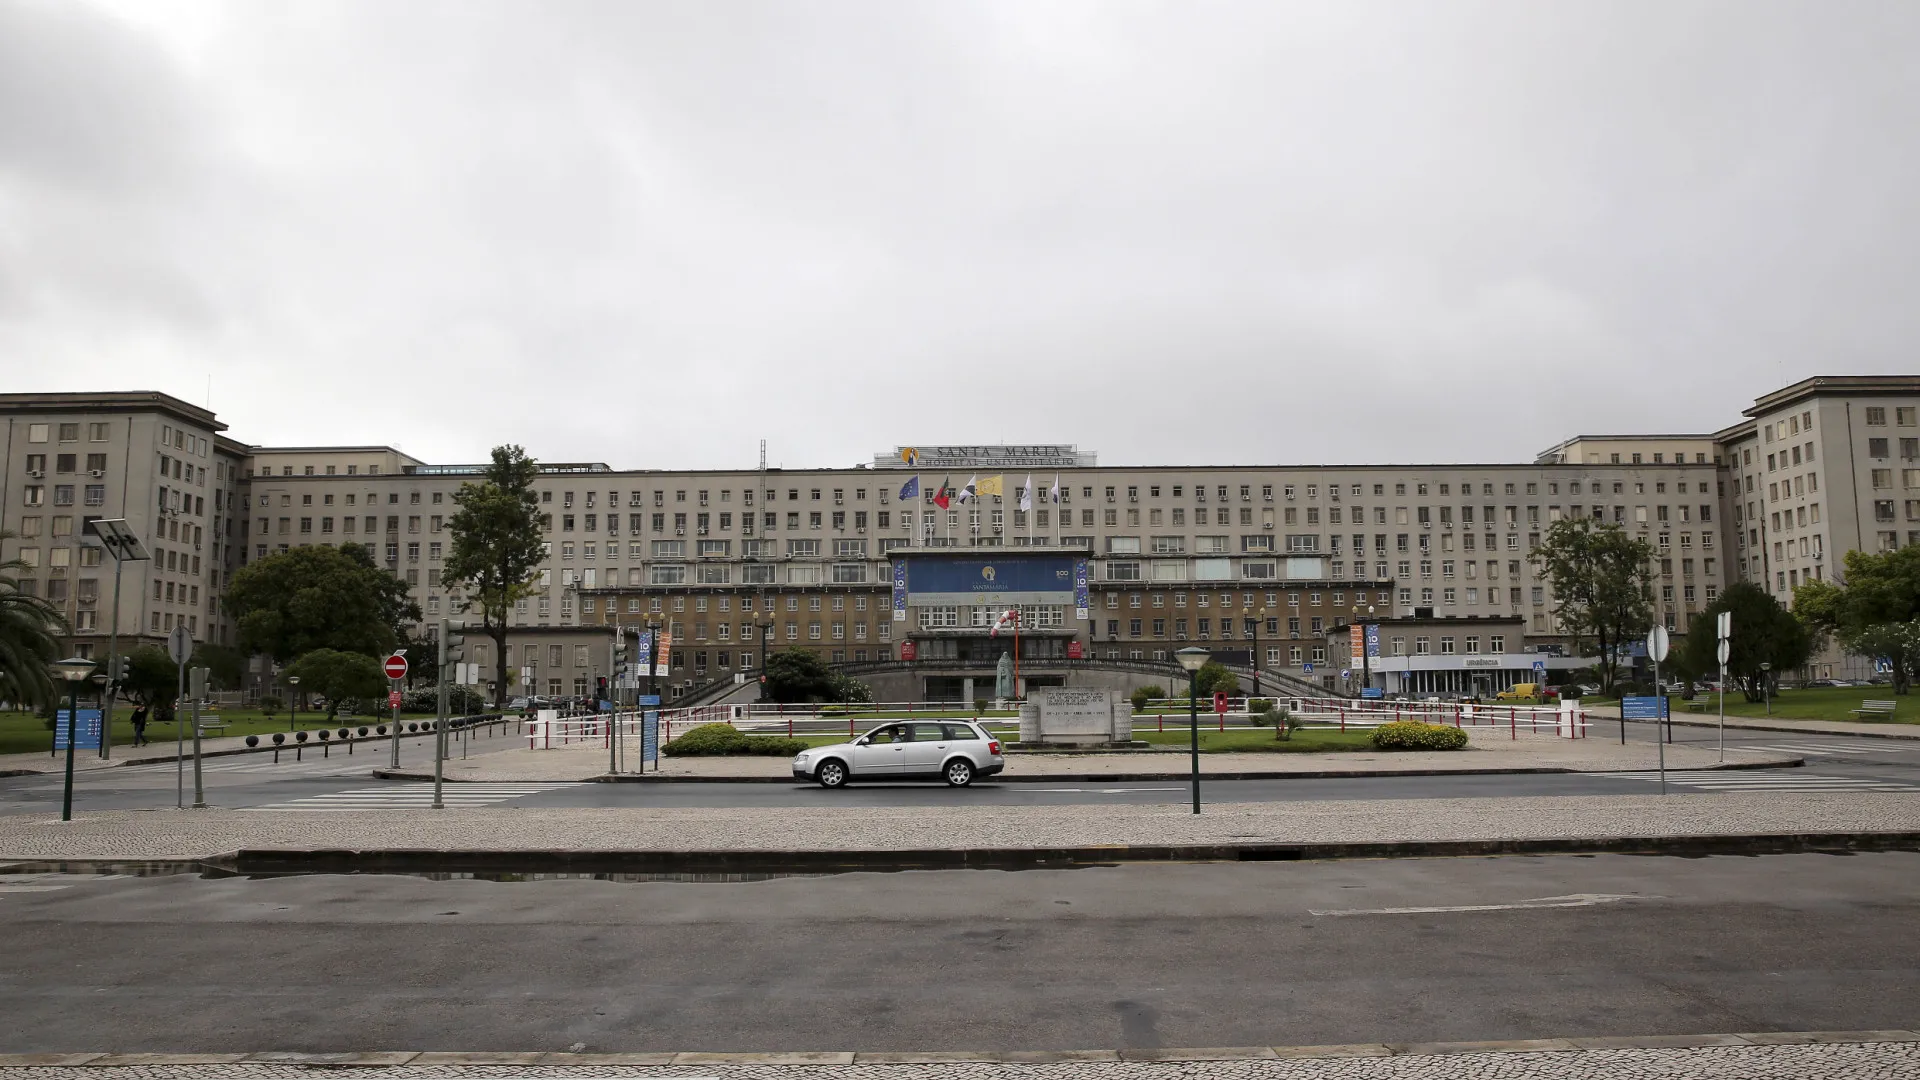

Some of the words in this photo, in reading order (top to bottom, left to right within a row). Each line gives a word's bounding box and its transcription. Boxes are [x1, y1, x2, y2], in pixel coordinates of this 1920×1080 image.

[937, 446, 991, 458] SANTA
[1005, 446, 1061, 457] MARIA
[925, 459, 980, 467] HOSPITAL
[986, 458, 1074, 466] UNIVERSITÁRIO
